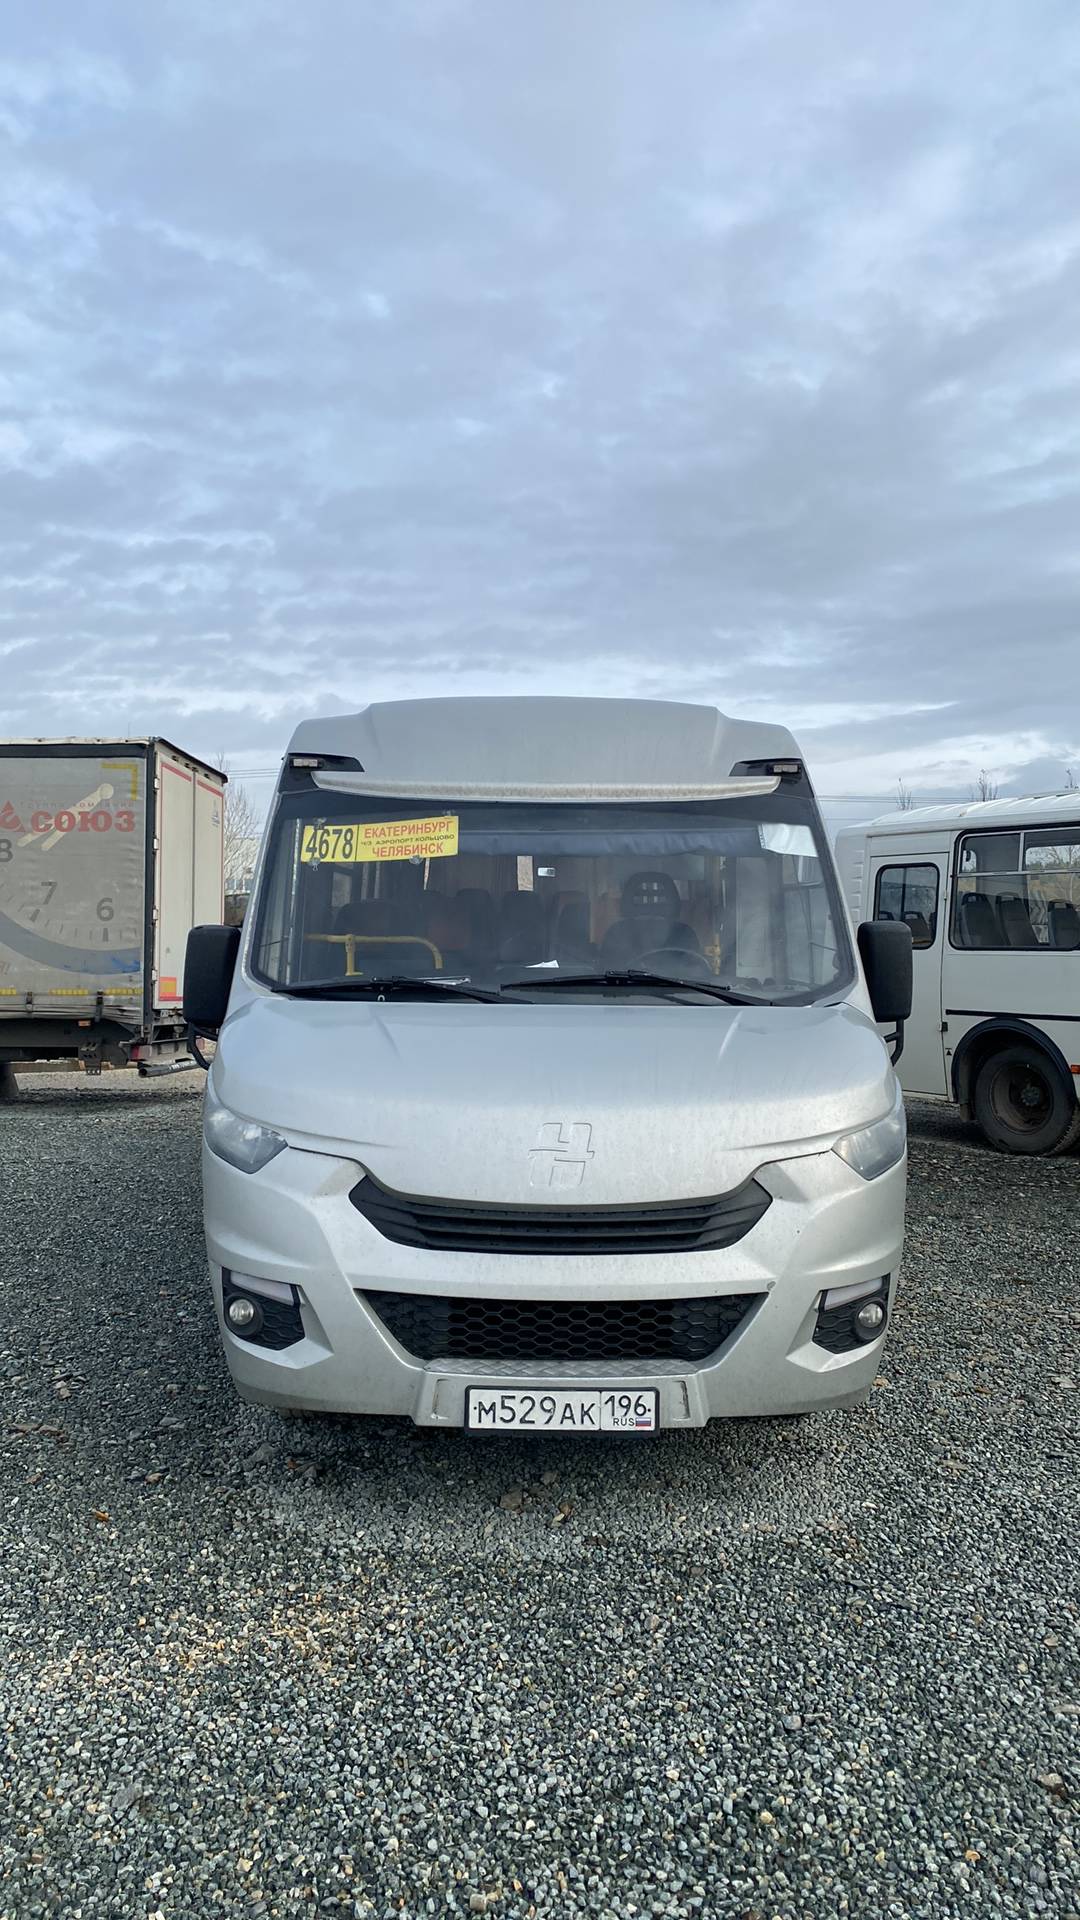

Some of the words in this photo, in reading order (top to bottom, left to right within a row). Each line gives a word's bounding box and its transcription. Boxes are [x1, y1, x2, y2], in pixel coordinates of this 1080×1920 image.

[31, 810, 137, 833] СОЮЗ
[364, 820, 454, 839] ЕКАТЕРИНБУРГ
[306, 828, 354, 860] 4678
[372, 841, 444, 858] ЧЕЛЯБИНСК
[375, 836, 414, 845] АЭРОПОРТ
[414, 833, 455, 842] КОЛЬЦОВО
[40, 881, 58, 905] 7
[96, 897, 114, 922] 6
[477, 1395, 596, 1425] М529АК
[604, 1394, 648, 1417] 196
[612, 1417, 635, 1427] RUS
